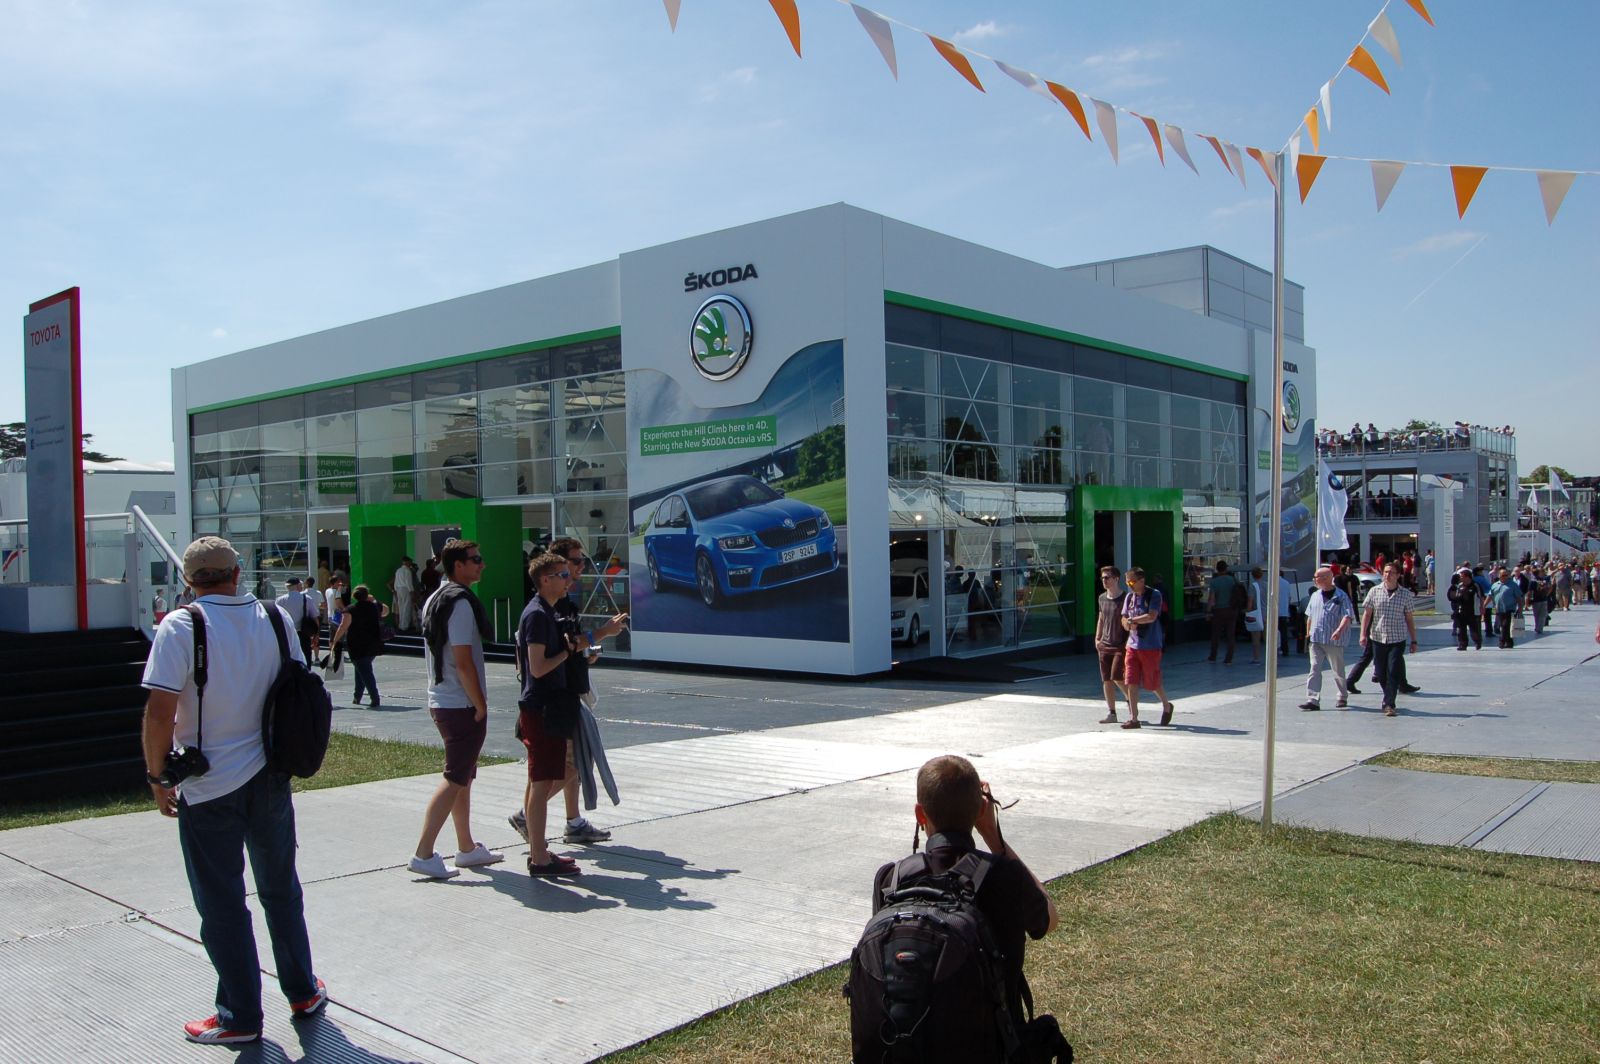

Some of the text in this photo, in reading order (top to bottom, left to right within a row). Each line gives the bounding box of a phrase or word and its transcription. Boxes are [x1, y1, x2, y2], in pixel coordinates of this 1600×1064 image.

[684, 263, 758, 292] ŠKODA
[30, 323, 61, 347] TOYOTA
[643, 420, 769, 441] Experience the Hill Climb here in 4D.
[643, 432, 774, 453] Starring the New ŠKODA Octavia vRS.
[783, 545, 815, 562] 2SP 9245
